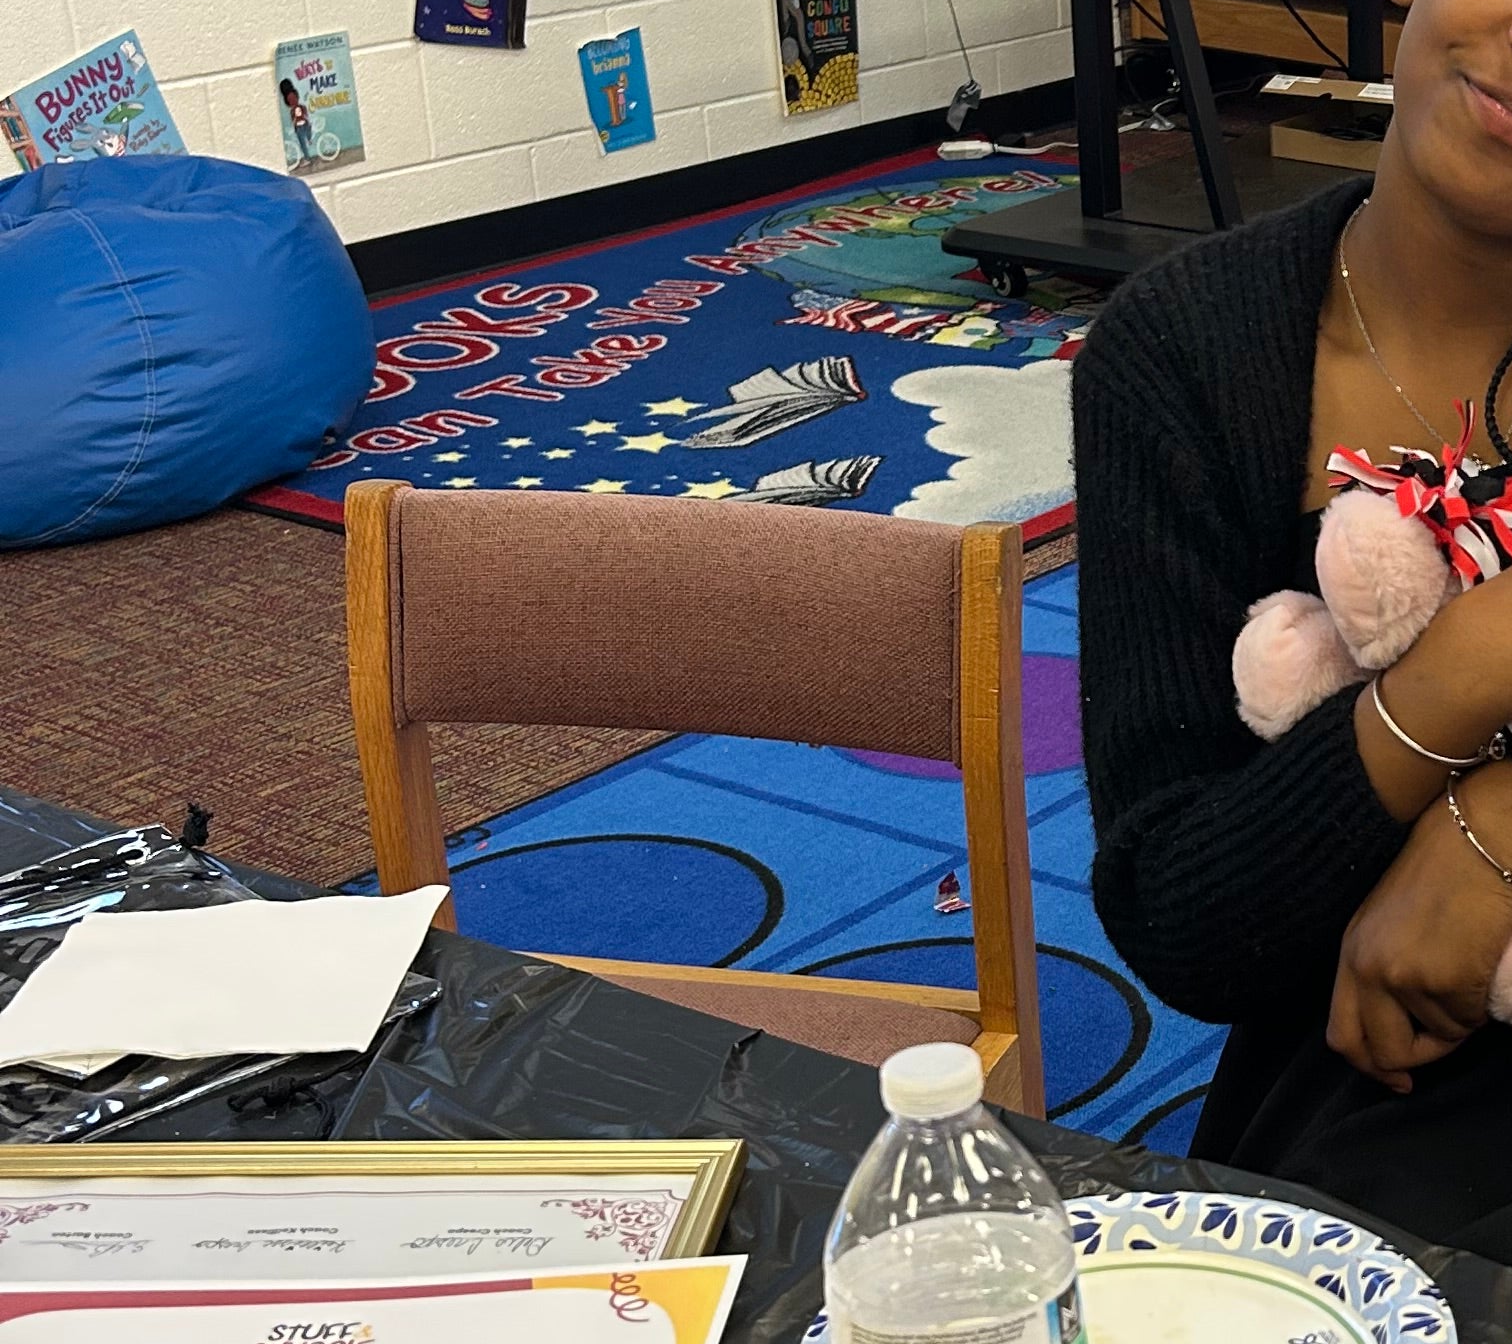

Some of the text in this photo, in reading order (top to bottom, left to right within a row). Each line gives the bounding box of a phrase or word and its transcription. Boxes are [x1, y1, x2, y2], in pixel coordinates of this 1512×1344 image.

[806, 15, 851, 38] SQUARE
[35, 52, 124, 124] BUNNY
[309, 73, 338, 94] MAKE
[43, 76, 136, 153] Figures It Out
[454, 333, 668, 403] Take
[587, 278, 726, 329] You
[684, 170, 1062, 276] Anywhere!
[268, 1322, 361, 1341] STUFF
